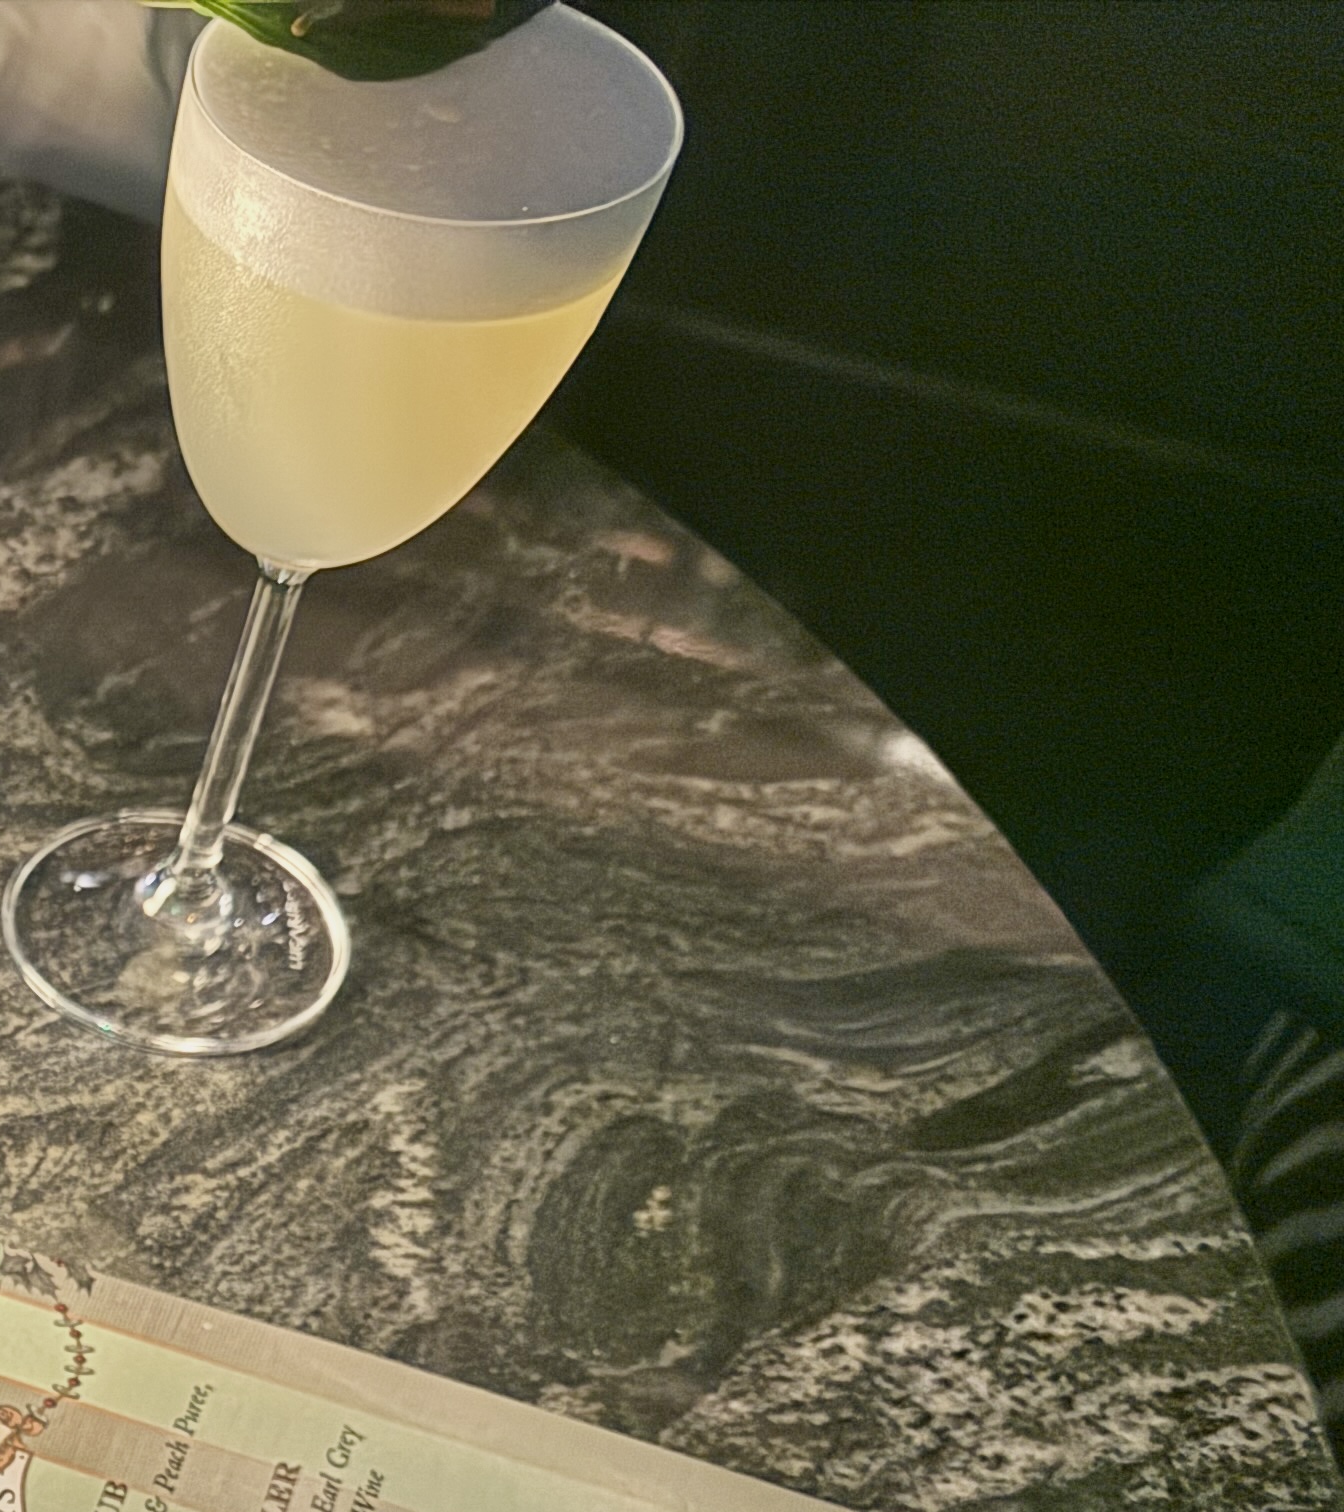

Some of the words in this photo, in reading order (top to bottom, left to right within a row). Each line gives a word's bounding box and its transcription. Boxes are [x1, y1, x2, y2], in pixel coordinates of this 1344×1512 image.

[151, 1440, 190, 1494] Peach
[171, 1383, 214, 1437] Puree,
[325, 1423, 366, 1469] Grey
